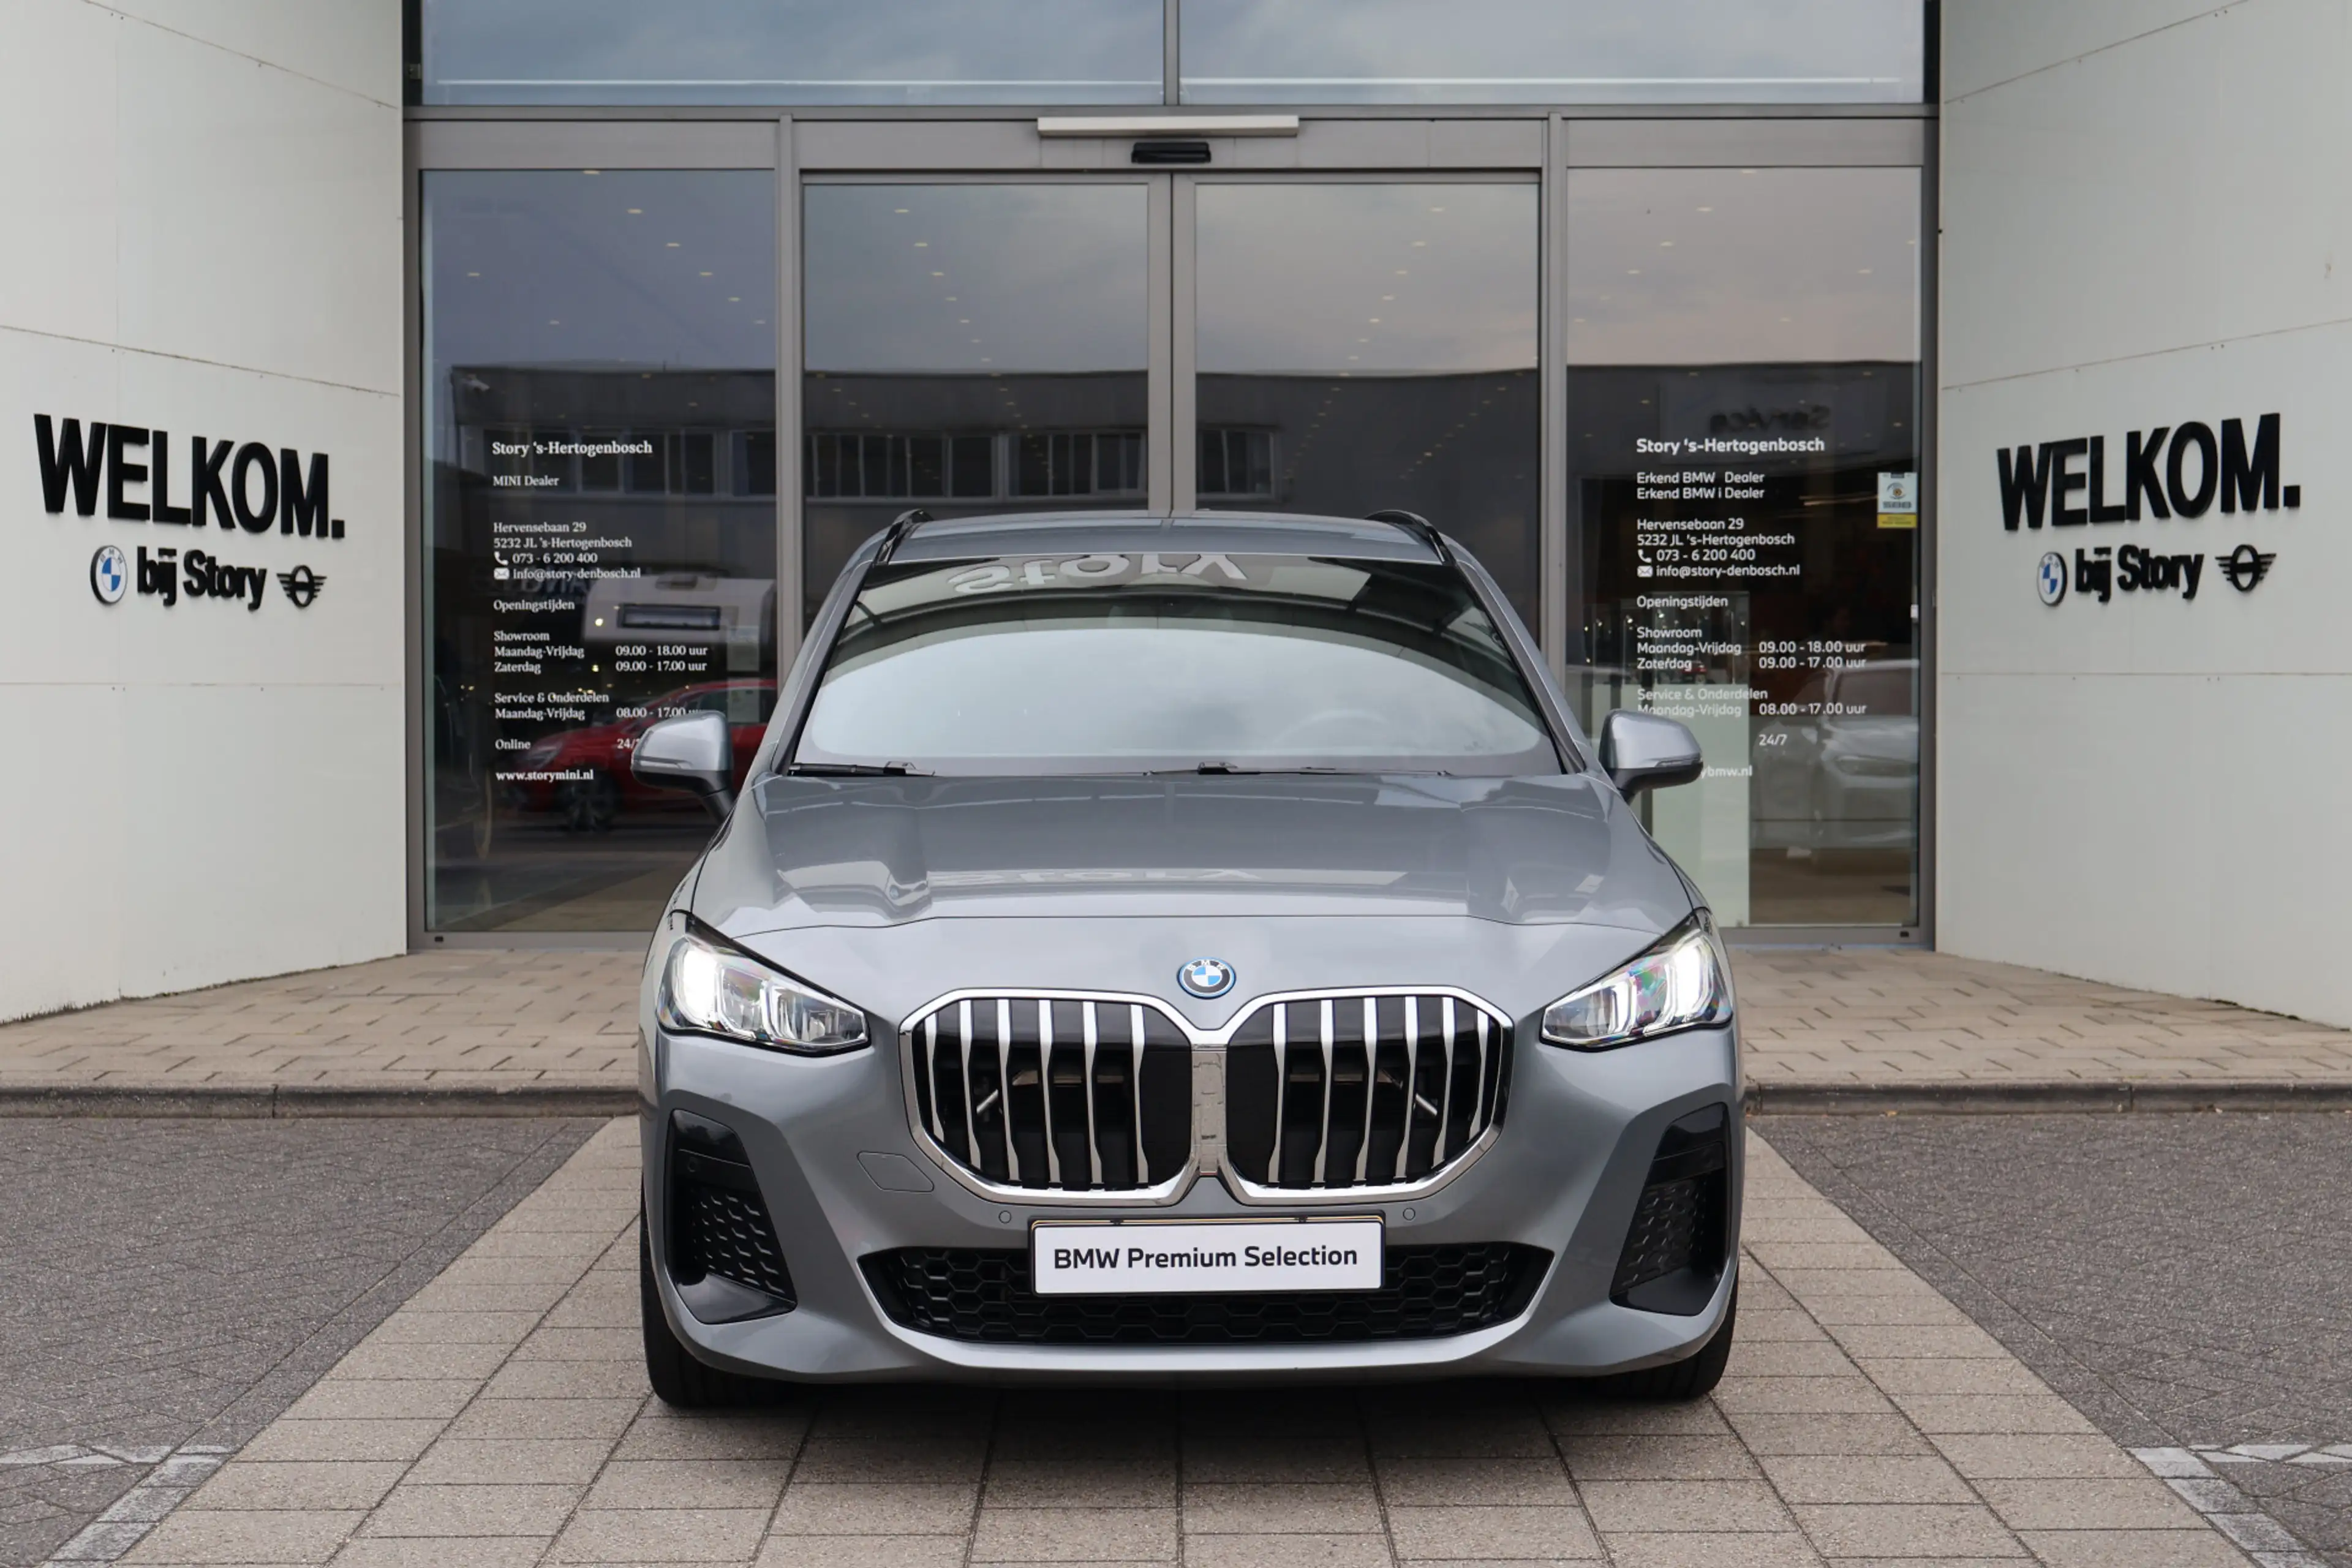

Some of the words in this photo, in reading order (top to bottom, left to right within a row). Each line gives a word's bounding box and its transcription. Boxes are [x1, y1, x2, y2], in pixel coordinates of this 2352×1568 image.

[492, 441, 530, 458] Story
[1636, 437, 1681, 456] Story
[34, 413, 345, 539] WELKOM.
[1636, 472, 1680, 484] Erkend
[1683, 471, 1716, 484] BMW
[1724, 470, 1765, 484] Dealer
[1997, 413, 2301, 532] WELKOM.
[492, 475, 521, 486] MINI
[524, 475, 559, 486] Dealer
[1636, 488, 1680, 500] Erkend
[1683, 487, 1716, 499] BMW
[1718, 487, 1722, 499] i
[1724, 486, 1765, 499] Dealer
[493, 521, 570, 533] Hervensebaan
[572, 521, 587, 532] 29
[1637, 518, 1725, 530] Hervensebaan
[1728, 518, 1744, 530] 29
[493, 537, 521, 549] 5232
[523, 537, 537, 549] JL
[1637, 533, 1667, 546] 5232
[1670, 533, 1684, 546] JL
[512, 552, 534, 564] 073
[543, 552, 551, 564] 6
[553, 552, 574, 564] 200
[576, 552, 598, 564] 400
[1656, 549, 1680, 562] 073
[1691, 549, 1700, 562] 6
[1702, 549, 1728, 561] 200
[1730, 549, 1756, 561] 400
[137, 546, 178, 606] bij
[184, 549, 266, 611] Story
[513, 567, 641, 581] info@story-denbosch.nl
[1656, 564, 1801, 579] info@story-denbosch.nl
[2075, 547, 2111, 603] bij
[2117, 544, 2204, 600] Story
[493, 598, 575, 613] Openingstijden
[1636, 595, 1728, 610] Openingstijden
[493, 630, 550, 642] Showroom
[1636, 626, 1703, 639] Showroom
[494, 645, 585, 660] Maandag-Vrijdag
[615, 646, 647, 657] 09.00
[657, 646, 687, 656] 18.00
[688, 647, 708, 656] uur
[1637, 641, 1742, 656] Maandag-Vrijdag
[1758, 640, 1796, 654] 09.00
[1807, 640, 1843, 653] 18.00
[1845, 643, 1866, 653] uur
[494, 661, 541, 675] Zaterdag
[615, 662, 647, 673] 09.00
[657, 660, 687, 672] 17.00
[688, 662, 707, 671] uur
[1637, 657, 1692, 672] Zaterdag
[1758, 656, 1797, 669] 09.00
[1845, 659, 1866, 669] uur
[494, 692, 535, 704] Service
[537, 692, 545, 703] &
[547, 692, 610, 703] Onderdelen
[1637, 688, 1681, 700] Service
[1684, 688, 1695, 700] &
[1697, 687, 1768, 700] Onderdelen
[495, 707, 586, 722] Maandag-Vrijdag
[616, 707, 647, 718] 08.00
[657, 706, 686, 718] 17.00
[1758, 703, 1798, 715] 08.00
[1845, 705, 1867, 715] uur
[494, 738, 531, 750] Online
[1758, 734, 1787, 746] 24/7
[495, 769, 594, 783] www.storymini.nl
[1054, 1248, 1120, 1269] BMW
[1128, 1246, 1237, 1268] Premium
[1244, 1245, 1357, 1267] Selection
